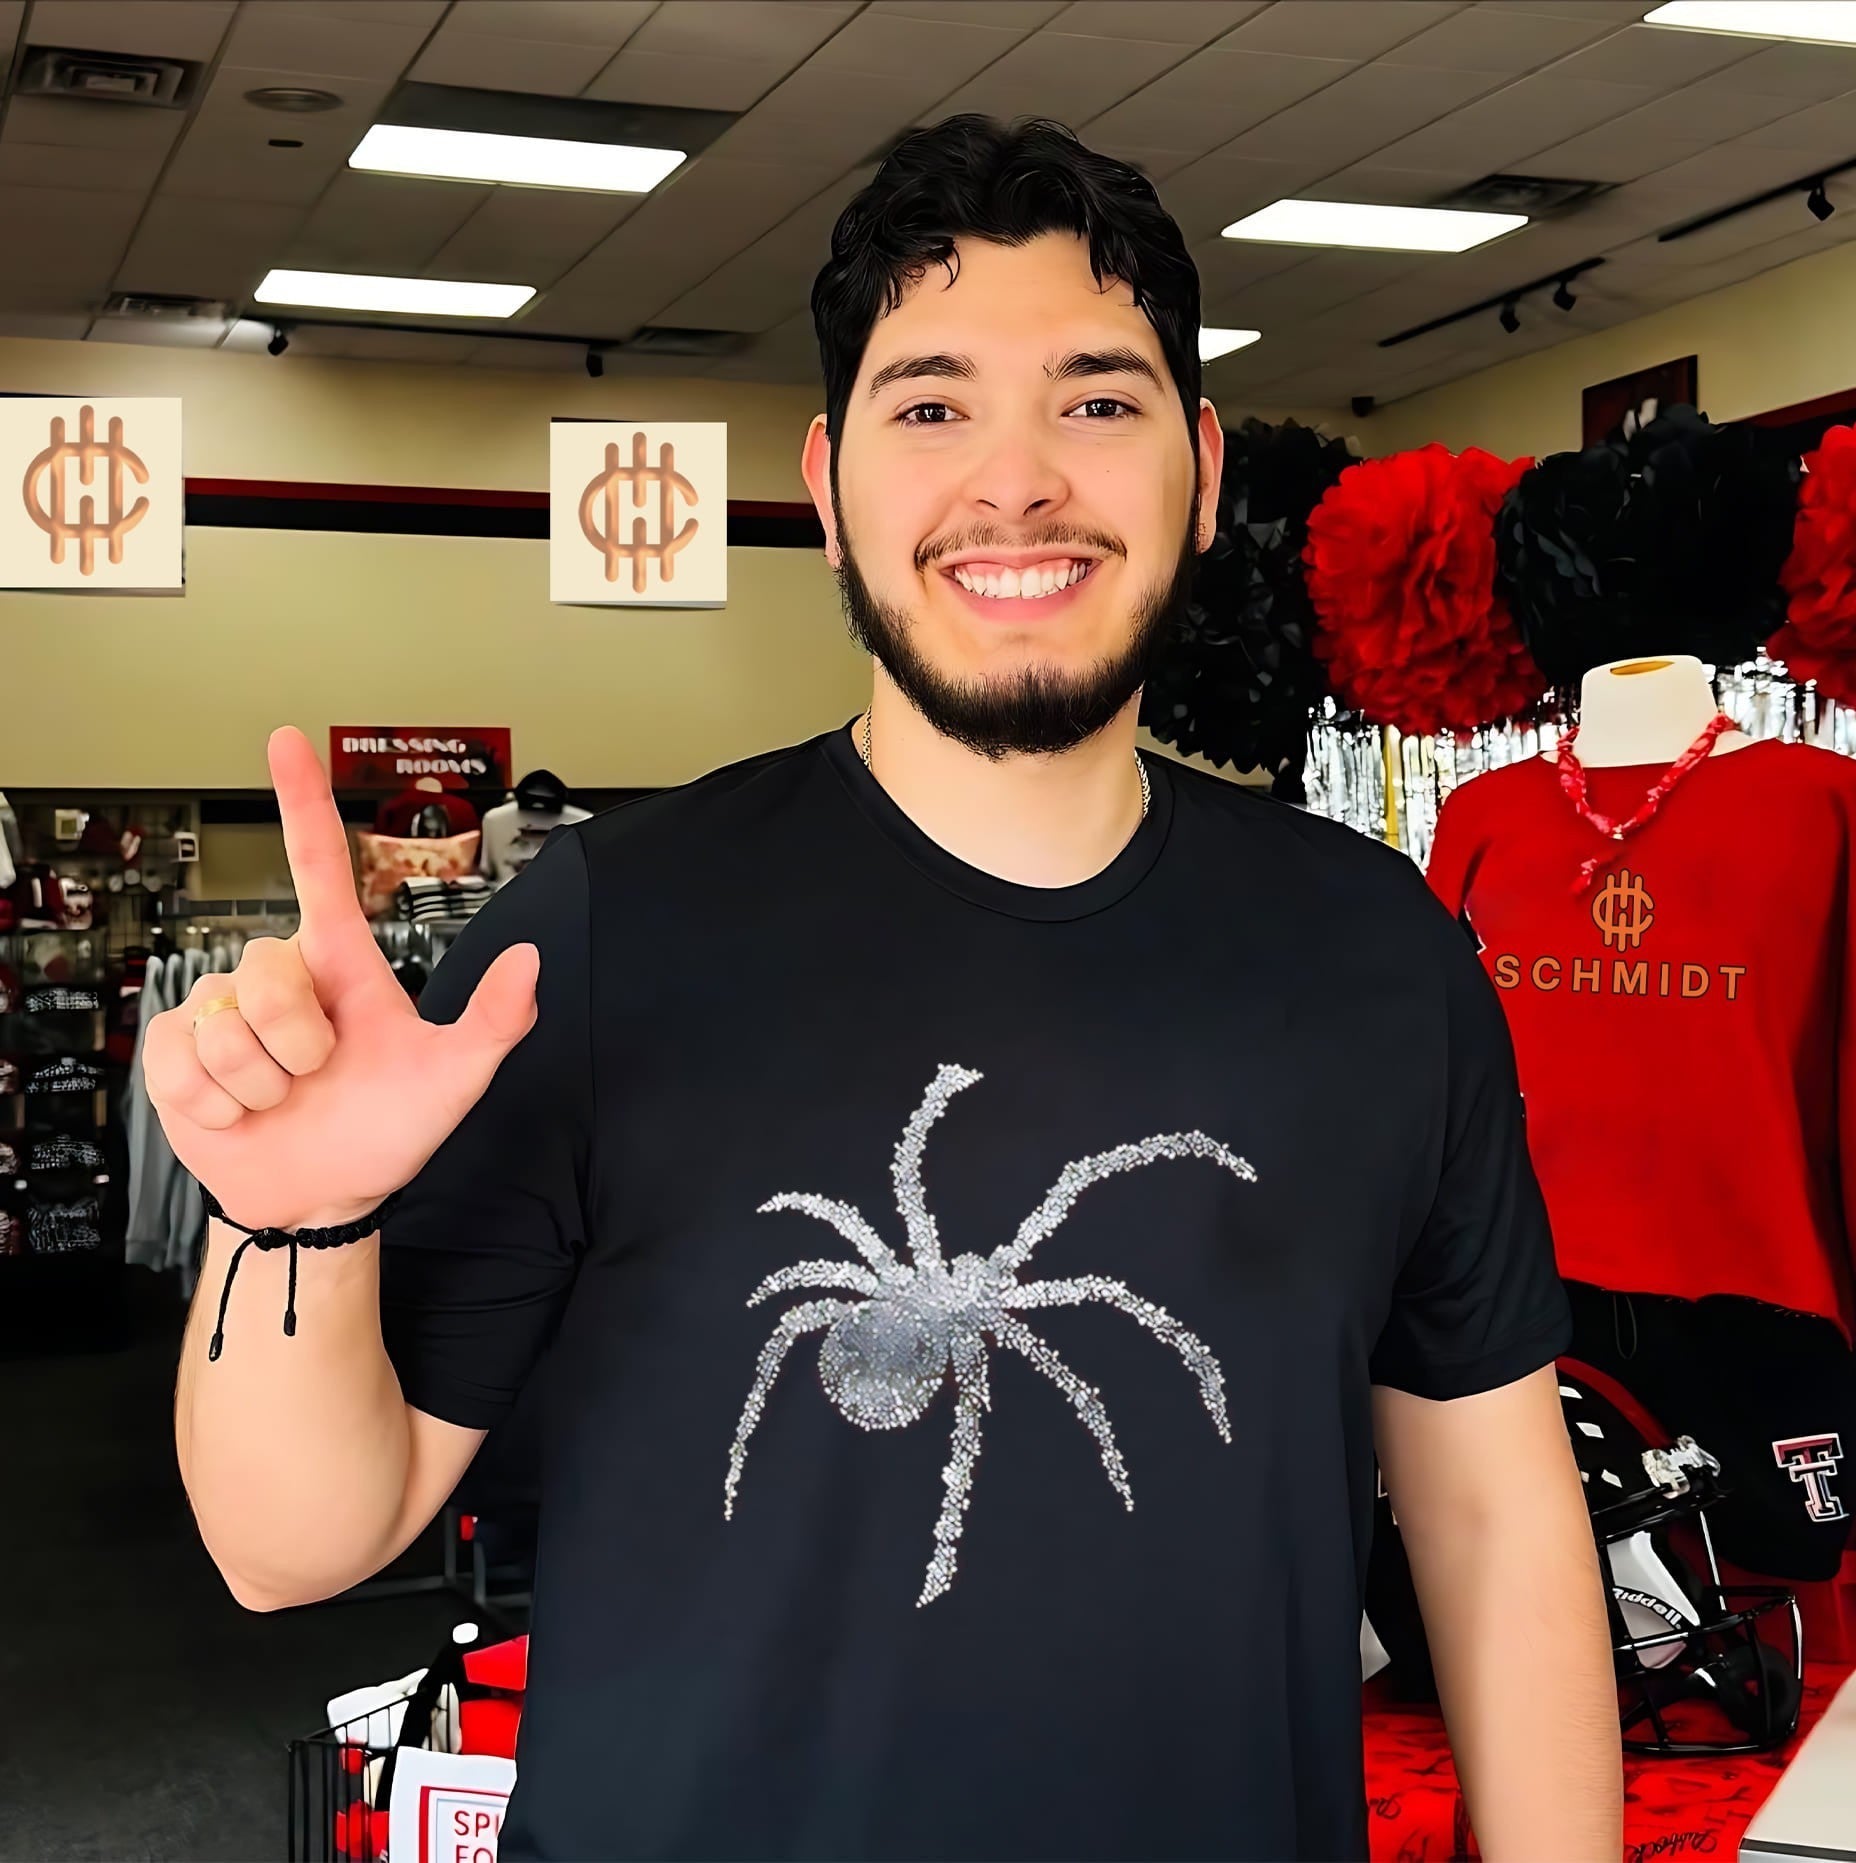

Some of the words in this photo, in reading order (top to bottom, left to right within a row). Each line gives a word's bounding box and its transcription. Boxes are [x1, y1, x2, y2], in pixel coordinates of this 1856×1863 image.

[342, 737, 467, 754] DRESSING
[396, 757, 487, 775] ROOMS
[1494, 953, 1748, 1001] SCHMIDT
